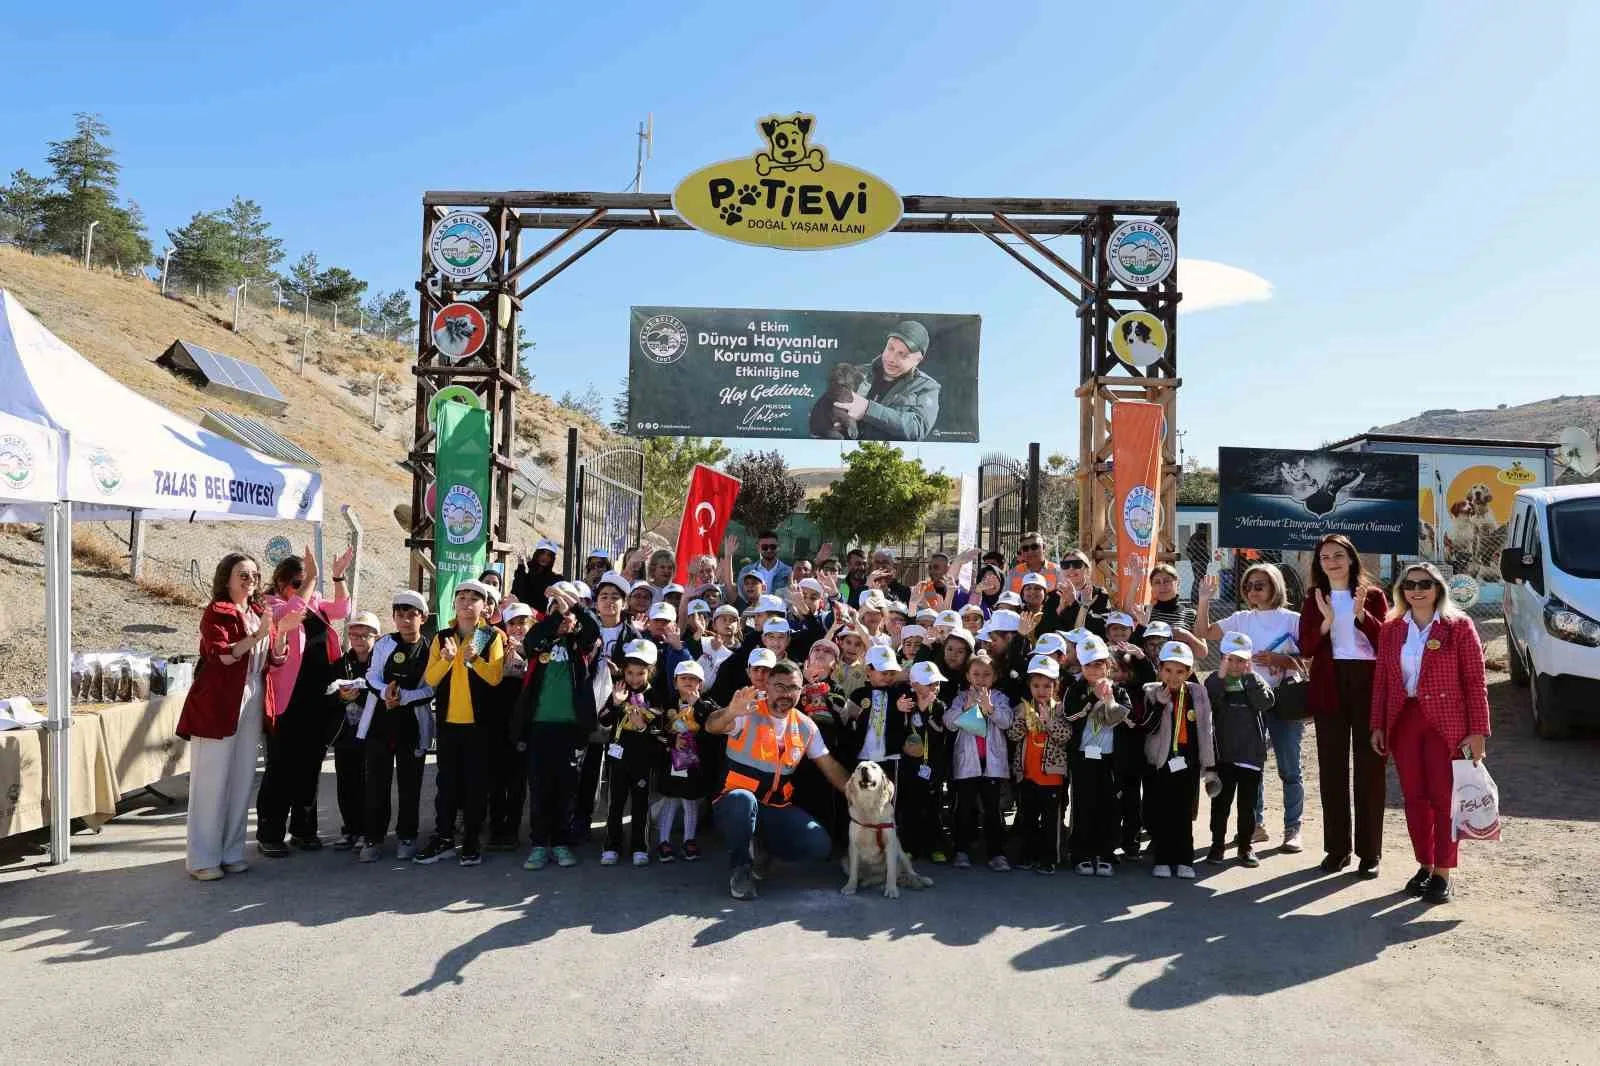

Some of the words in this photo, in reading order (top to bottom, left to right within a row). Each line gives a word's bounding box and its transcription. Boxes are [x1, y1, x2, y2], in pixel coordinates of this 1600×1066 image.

[747, 218, 787, 231] DOĞAL
[790, 220, 829, 235] YAŞAM
[831, 223, 865, 235] ALANI
[747, 320, 756, 332] 4
[760, 321, 790, 332] Ekim
[698, 332, 748, 347] Dünya
[753, 334, 838, 350] Hayvanları
[714, 349, 774, 363] Koruma
[780, 350, 822, 364] Günü
[735, 366, 800, 380] Etkinliğine
[719, 386, 748, 406] Hoş
[153, 470, 198, 498] TALAS
[204, 475, 274, 507] BELEDİYESİ
